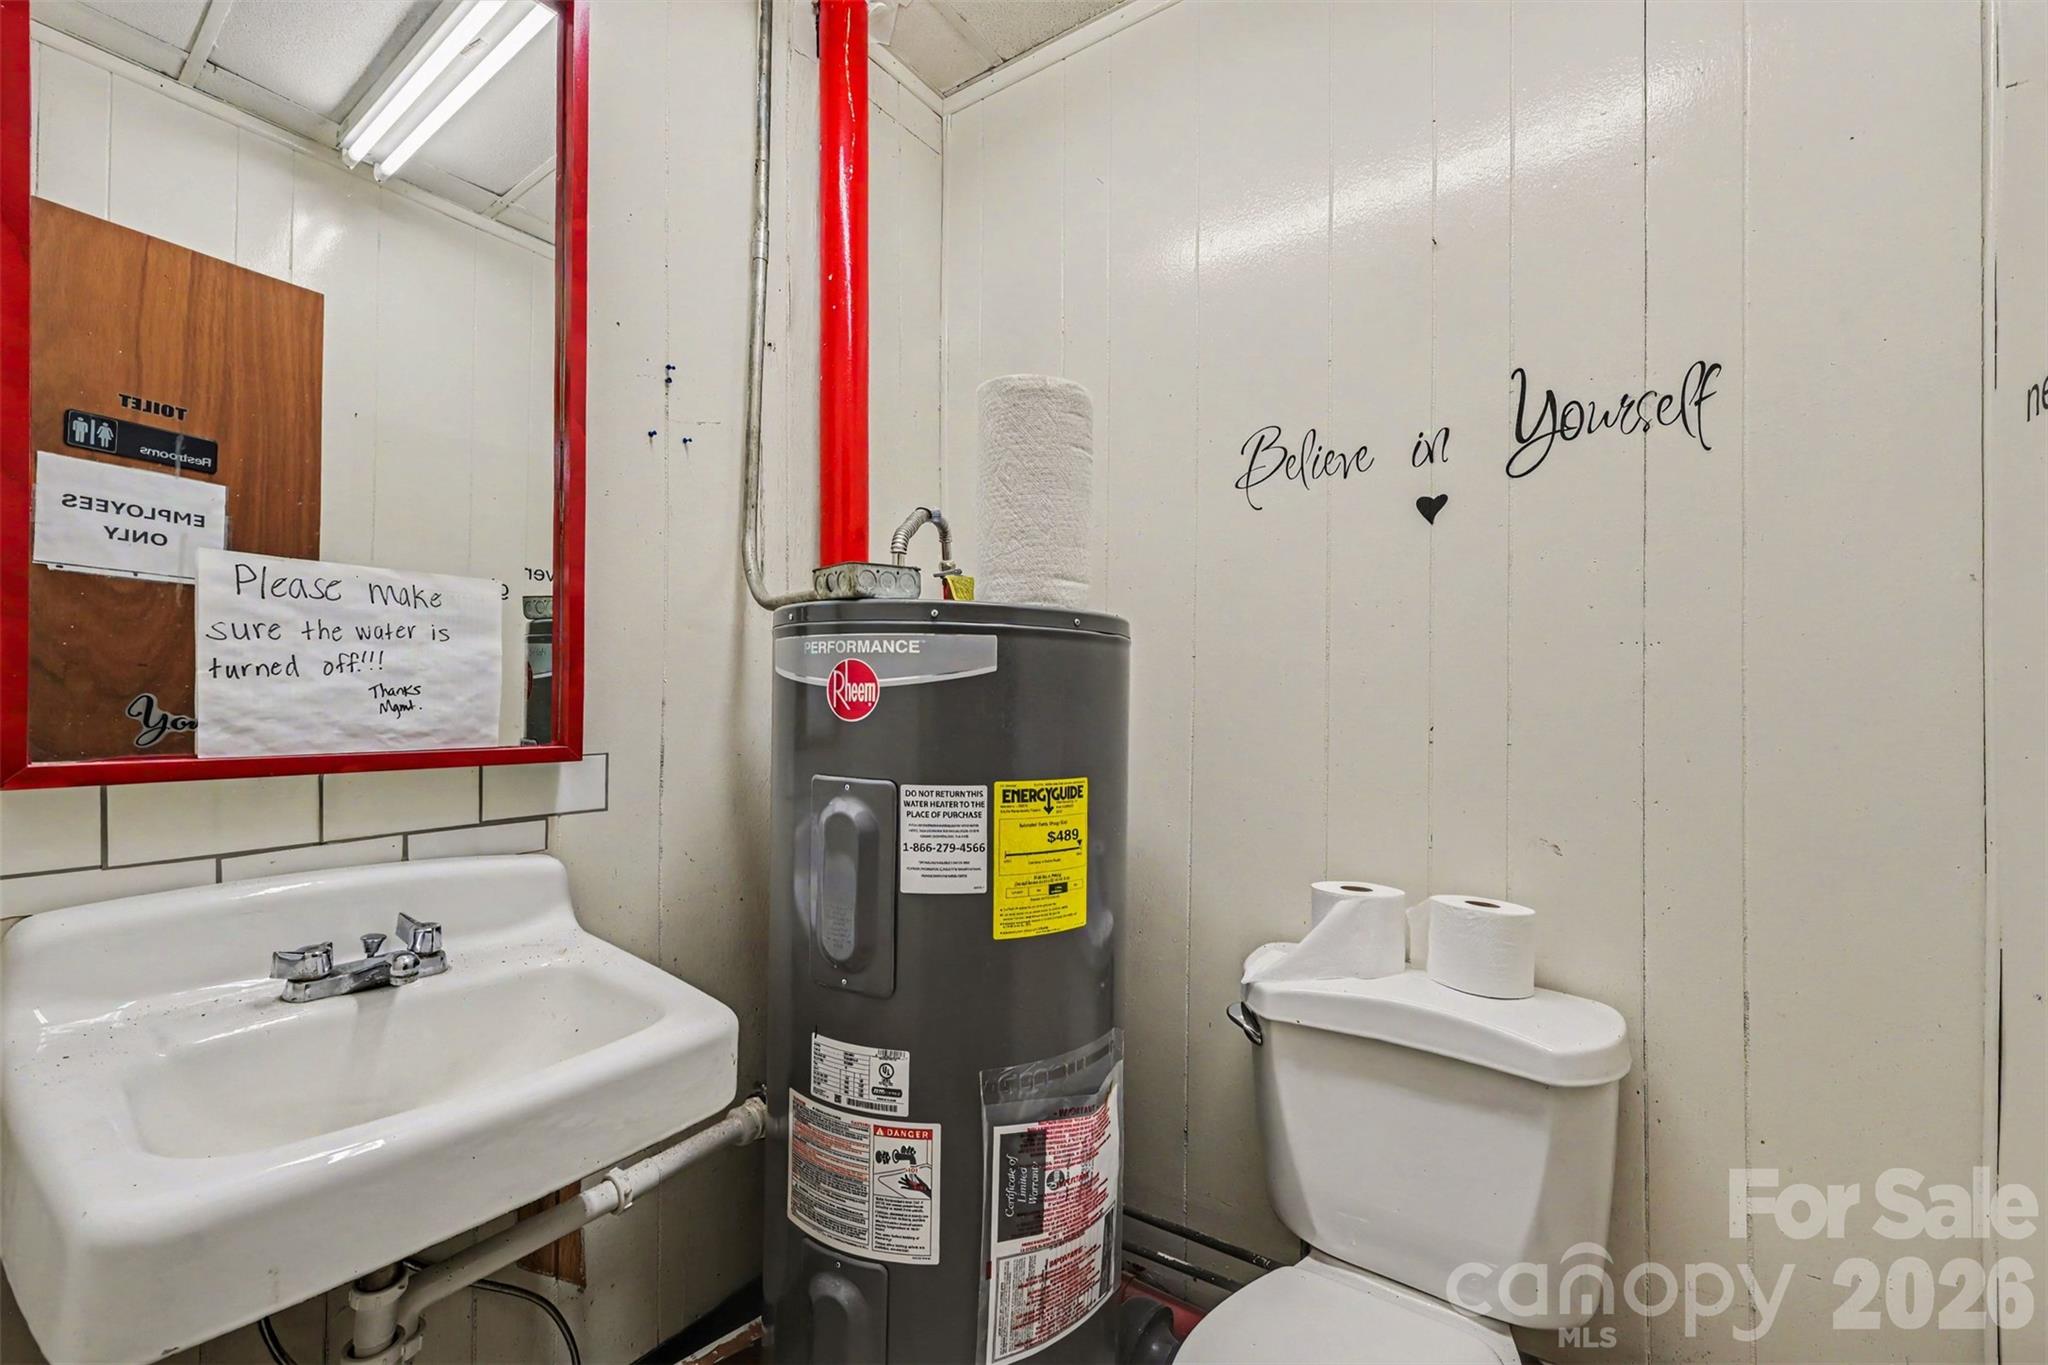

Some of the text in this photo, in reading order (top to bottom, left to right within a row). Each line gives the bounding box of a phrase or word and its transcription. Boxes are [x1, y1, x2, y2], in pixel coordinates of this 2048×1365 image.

[1235, 361, 1721, 510] Believe in Yourself
[235, 563, 342, 601] Please
[206, 619, 450, 642] sure the water is
[804, 639, 921, 654] PERFORMANCE
[208, 650, 384, 679] turned off!!!
[368, 683, 422, 697] Thanks
[833, 660, 876, 710] Rheem
[935, 790, 966, 798] RETURN
[1047, 828, 1079, 844] $489
[903, 843, 986, 853] 1-866-279-4566
[887, 1129, 929, 1139] DANGER
